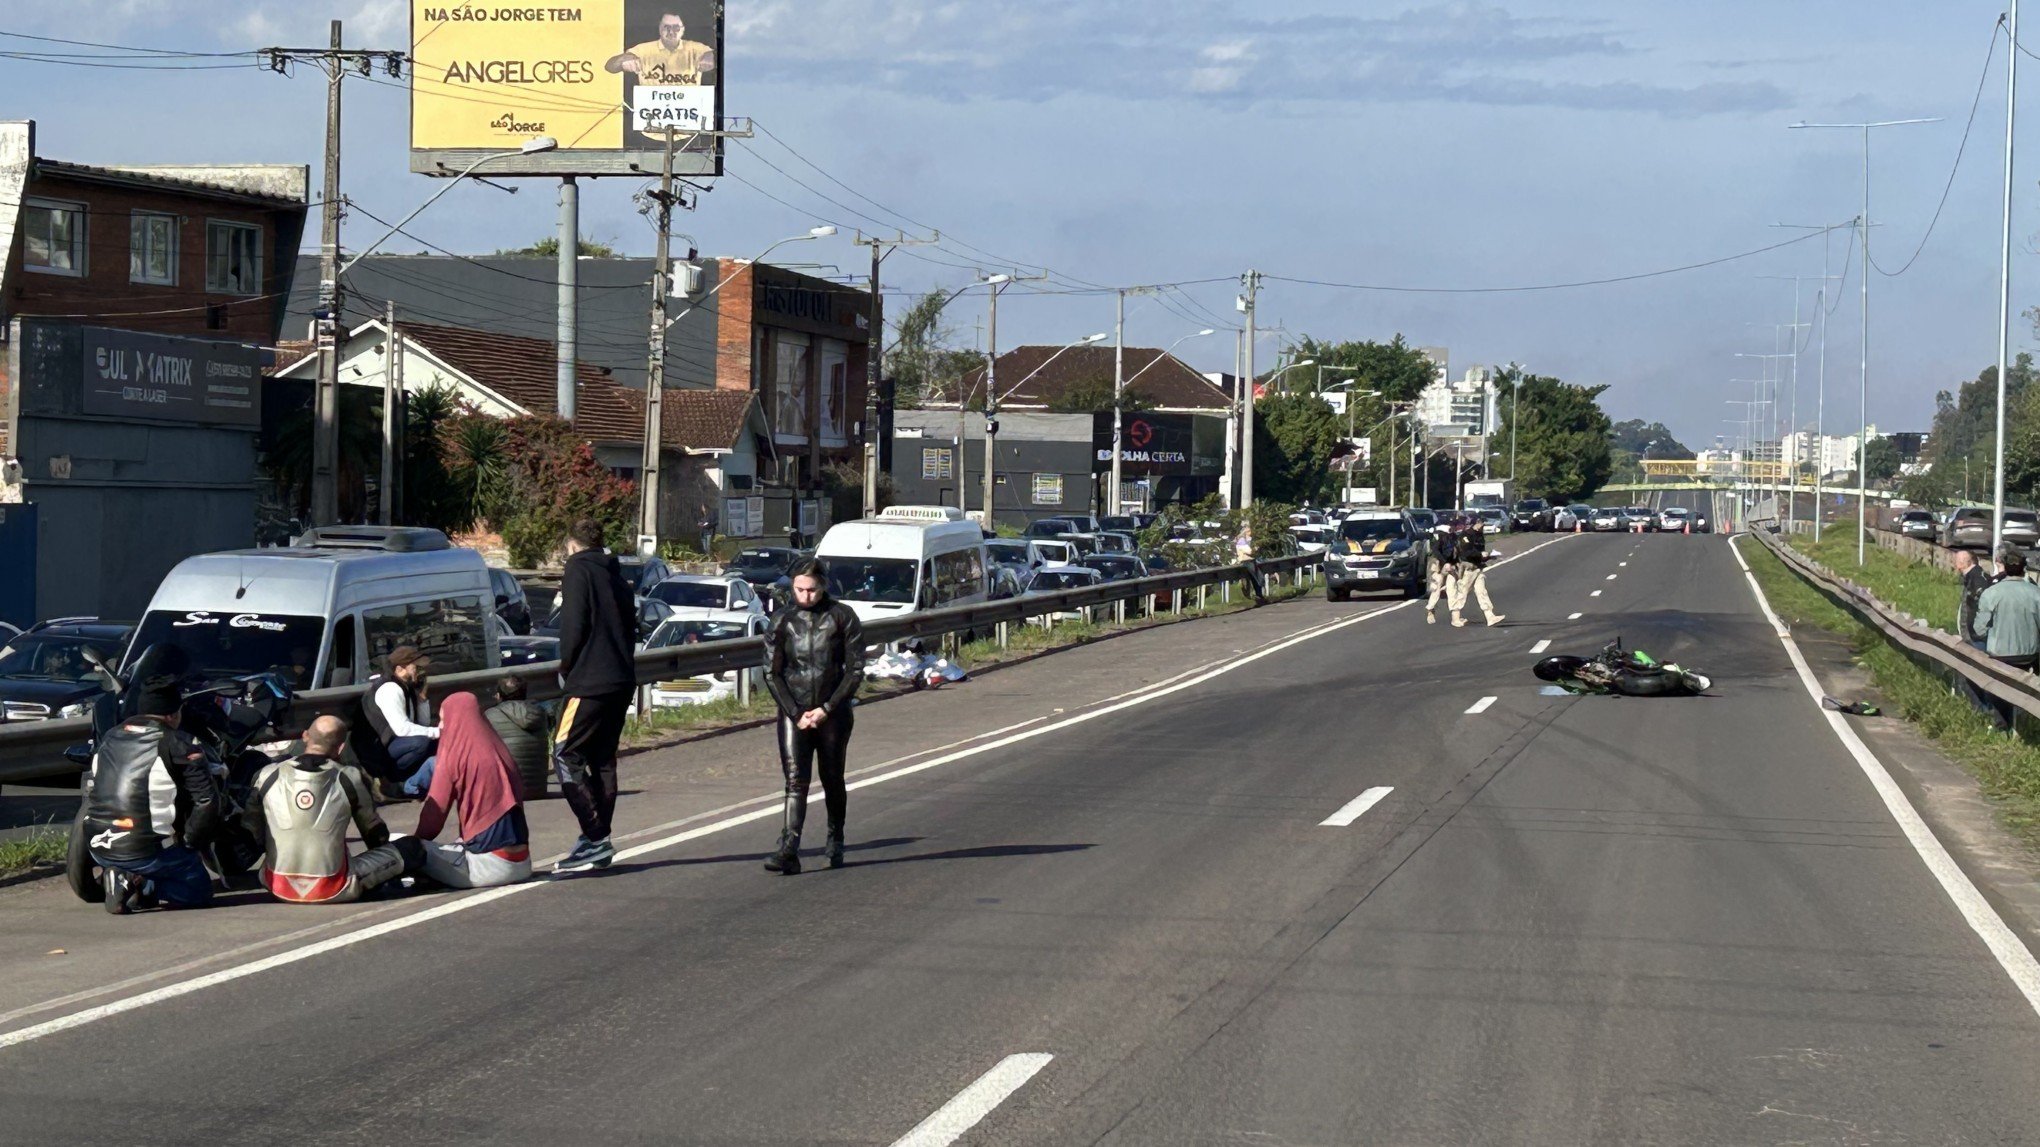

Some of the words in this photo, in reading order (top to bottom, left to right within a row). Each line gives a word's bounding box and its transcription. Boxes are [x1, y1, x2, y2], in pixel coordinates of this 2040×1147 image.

[424, 8, 449, 21] NA
[452, 5, 487, 21] SÃO
[490, 8, 545, 21] JORGE
[548, 8, 582, 21] TEM
[443, 60, 594, 83] ANGELGRES
[652, 91, 685, 100] Frete
[640, 104, 699, 121] GRÁTIS
[507, 112, 545, 132] JORGE
[1151, 451, 1185, 462] CERTA
